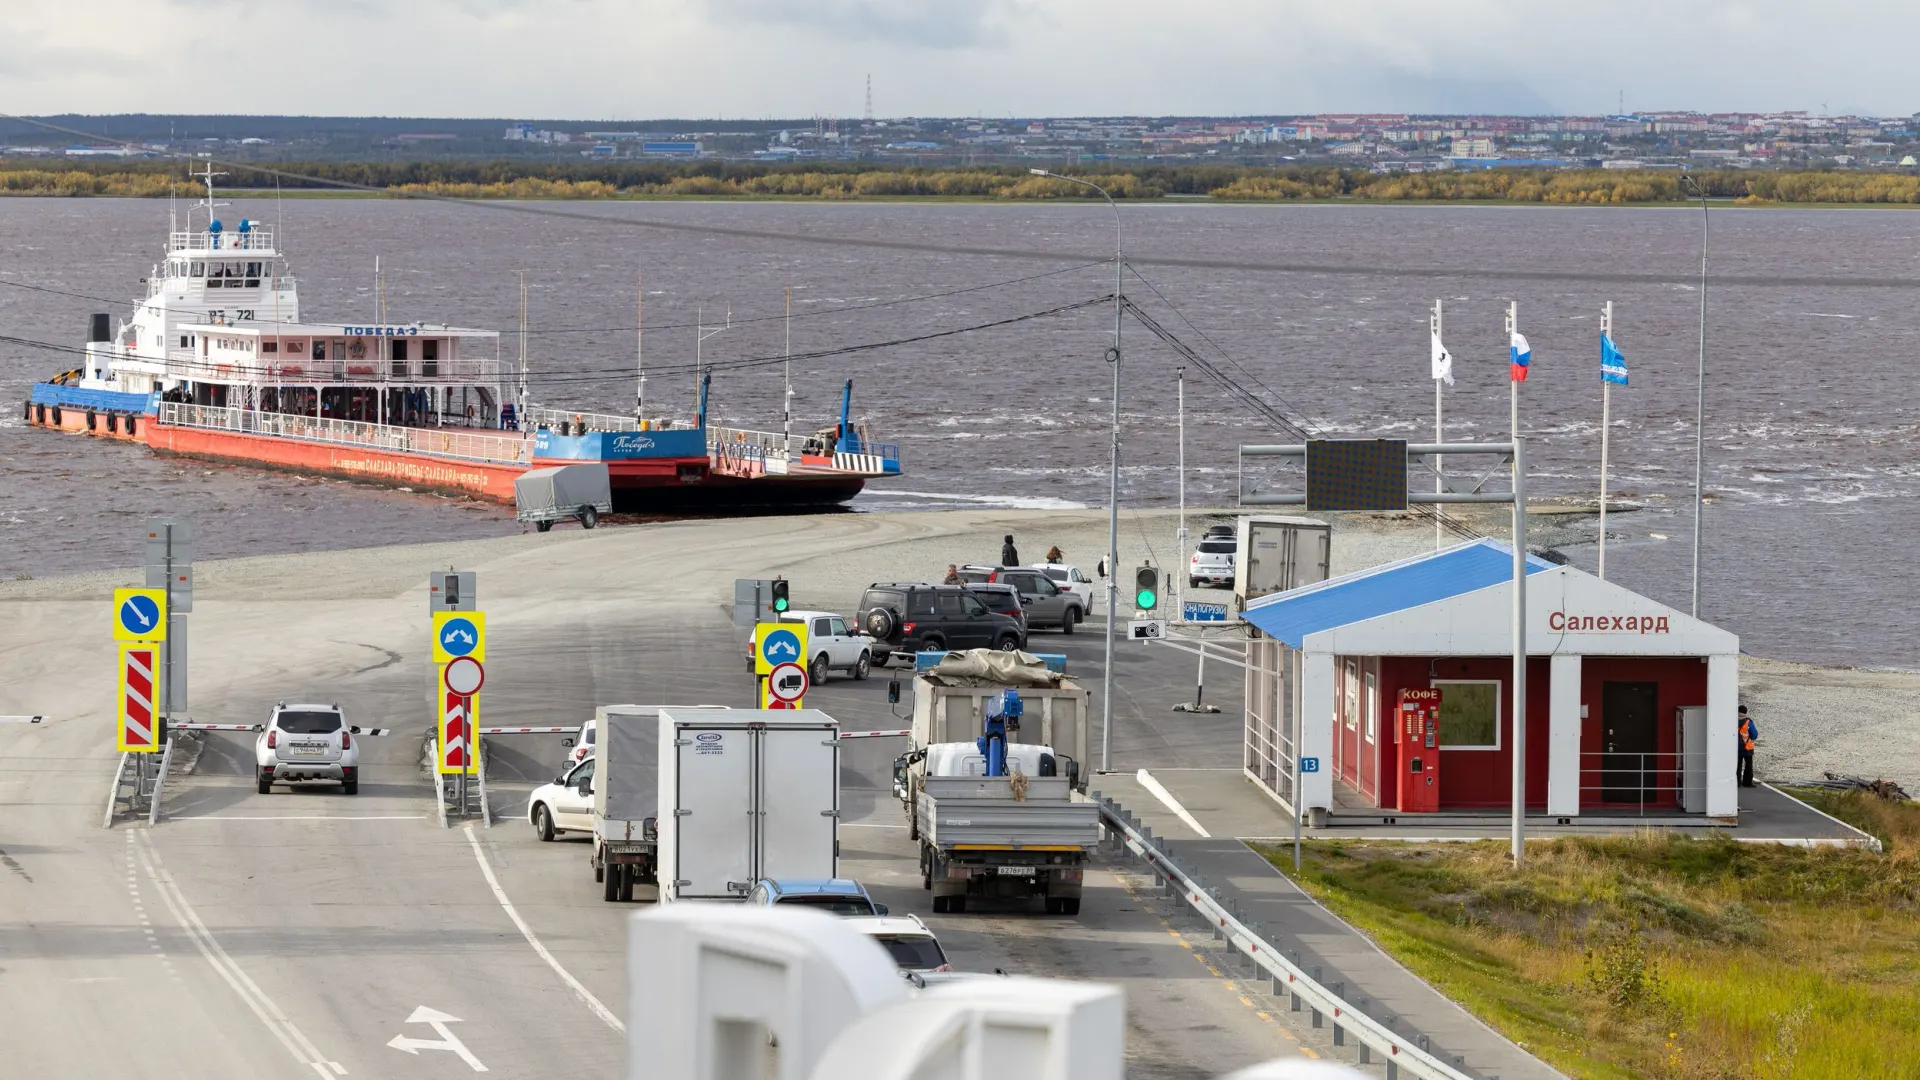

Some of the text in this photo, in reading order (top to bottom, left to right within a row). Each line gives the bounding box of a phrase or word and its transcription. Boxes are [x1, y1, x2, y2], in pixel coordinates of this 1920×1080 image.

[1549, 612, 1670, 634] Салехард
[1403, 690, 1438, 700] КОФЕ
[1304, 759, 1317, 771] 13
